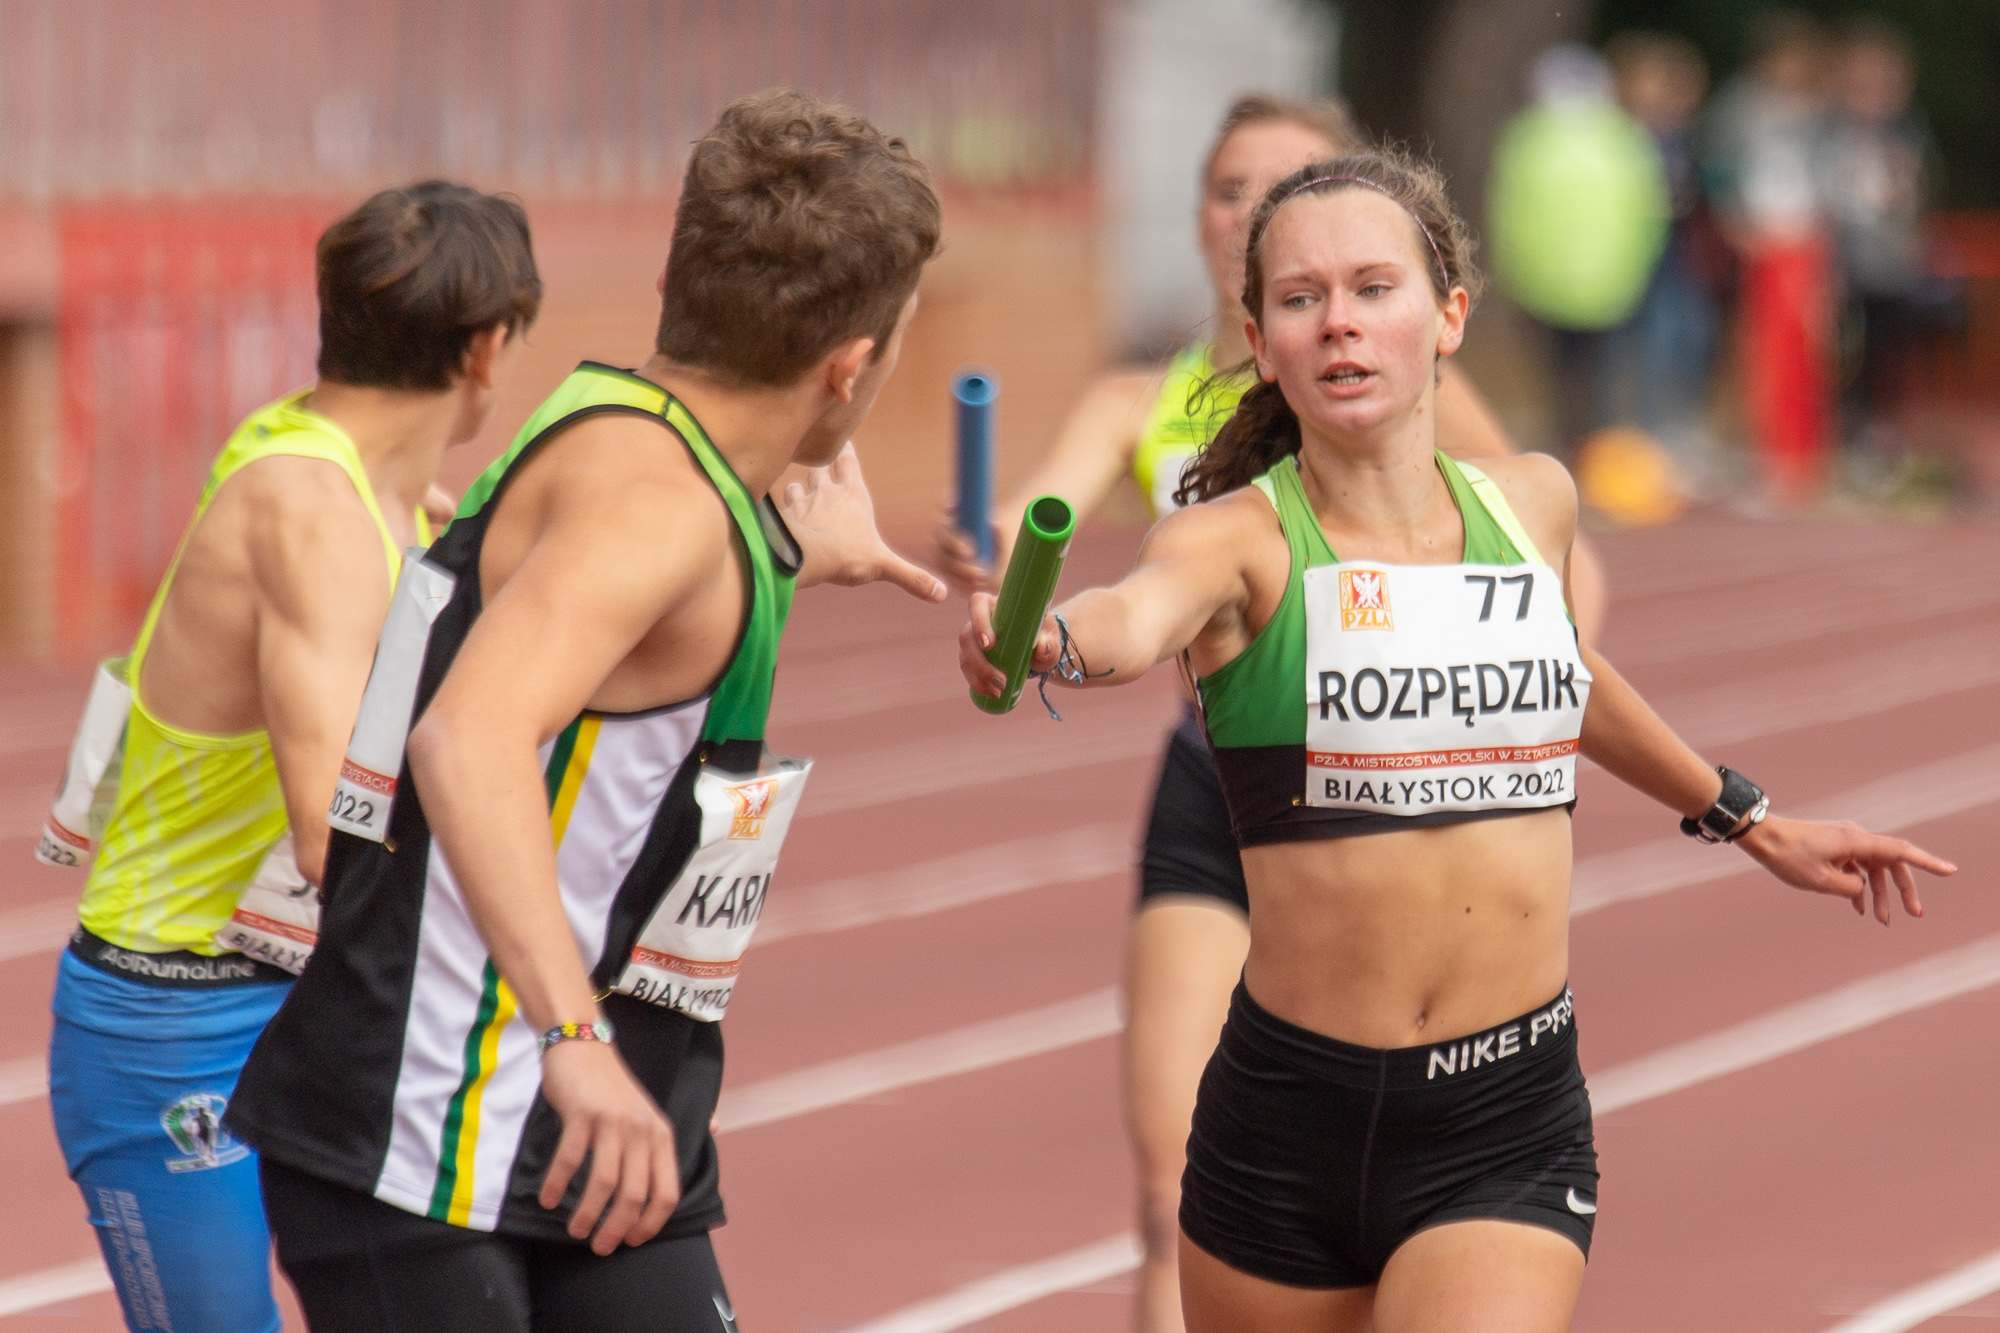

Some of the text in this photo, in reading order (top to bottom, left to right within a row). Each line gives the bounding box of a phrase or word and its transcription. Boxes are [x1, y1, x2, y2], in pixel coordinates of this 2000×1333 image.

[1464, 573, 1534, 622] 77
[1344, 611, 1392, 629] PZLA
[1319, 659, 1579, 728] ROZPĘDZIK
[1314, 742, 1574, 768] PZLA MISTRZOSTWA POLSKI W SZTAFETACH
[1324, 768, 1565, 805] BIAŁYSTOK 2022
[732, 820, 761, 837] PZLA
[637, 951, 666, 967] PZLA
[1427, 1024, 1521, 1080] NIKE
